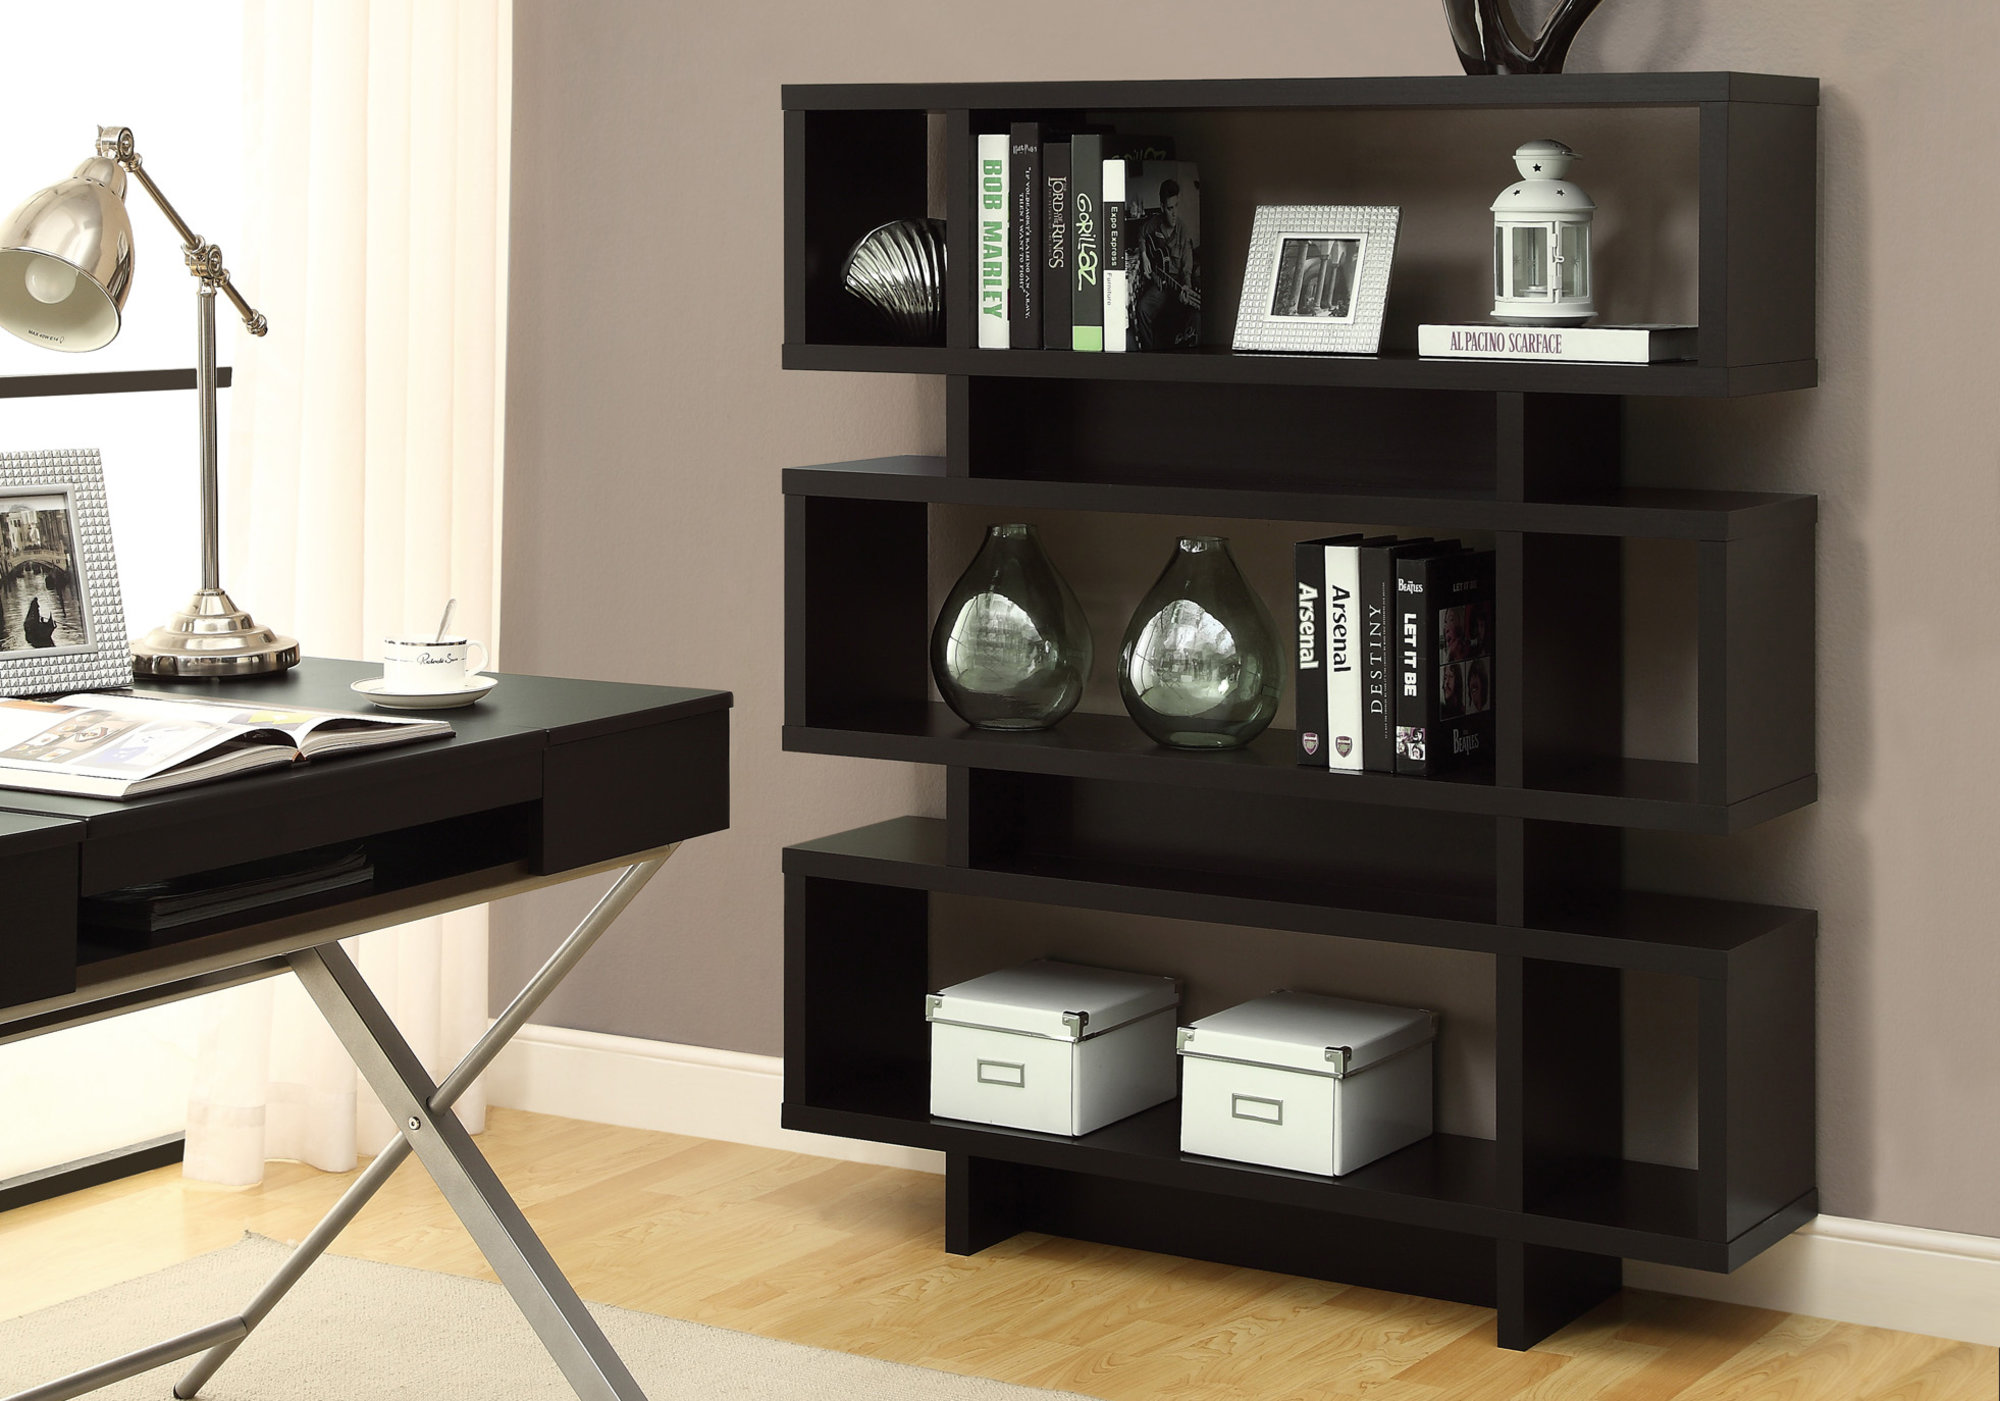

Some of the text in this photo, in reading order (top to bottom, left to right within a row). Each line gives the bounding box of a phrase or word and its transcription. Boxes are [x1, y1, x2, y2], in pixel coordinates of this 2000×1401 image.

[1048, 176, 1067, 212] LORD
[1058, 213, 1063, 222] OF
[1110, 206, 1118, 266] Expo Express
[983, 159, 1002, 319] BOB MARLEY
[1019, 253, 1024, 263] TO
[1048, 223, 1066, 268] RINGS
[1025, 275, 1031, 289] AN
[1450, 331, 1562, 354] AL PACINO SCARFACE
[1398, 578, 1424, 595] BEATLES
[1298, 582, 1319, 670] Arsenal
[1332, 585, 1351, 673] Arsenal
[1369, 604, 1383, 714] DESTINY
[1404, 613, 1417, 697] LET IT BE
[1452, 728, 1480, 756] BEATLES
